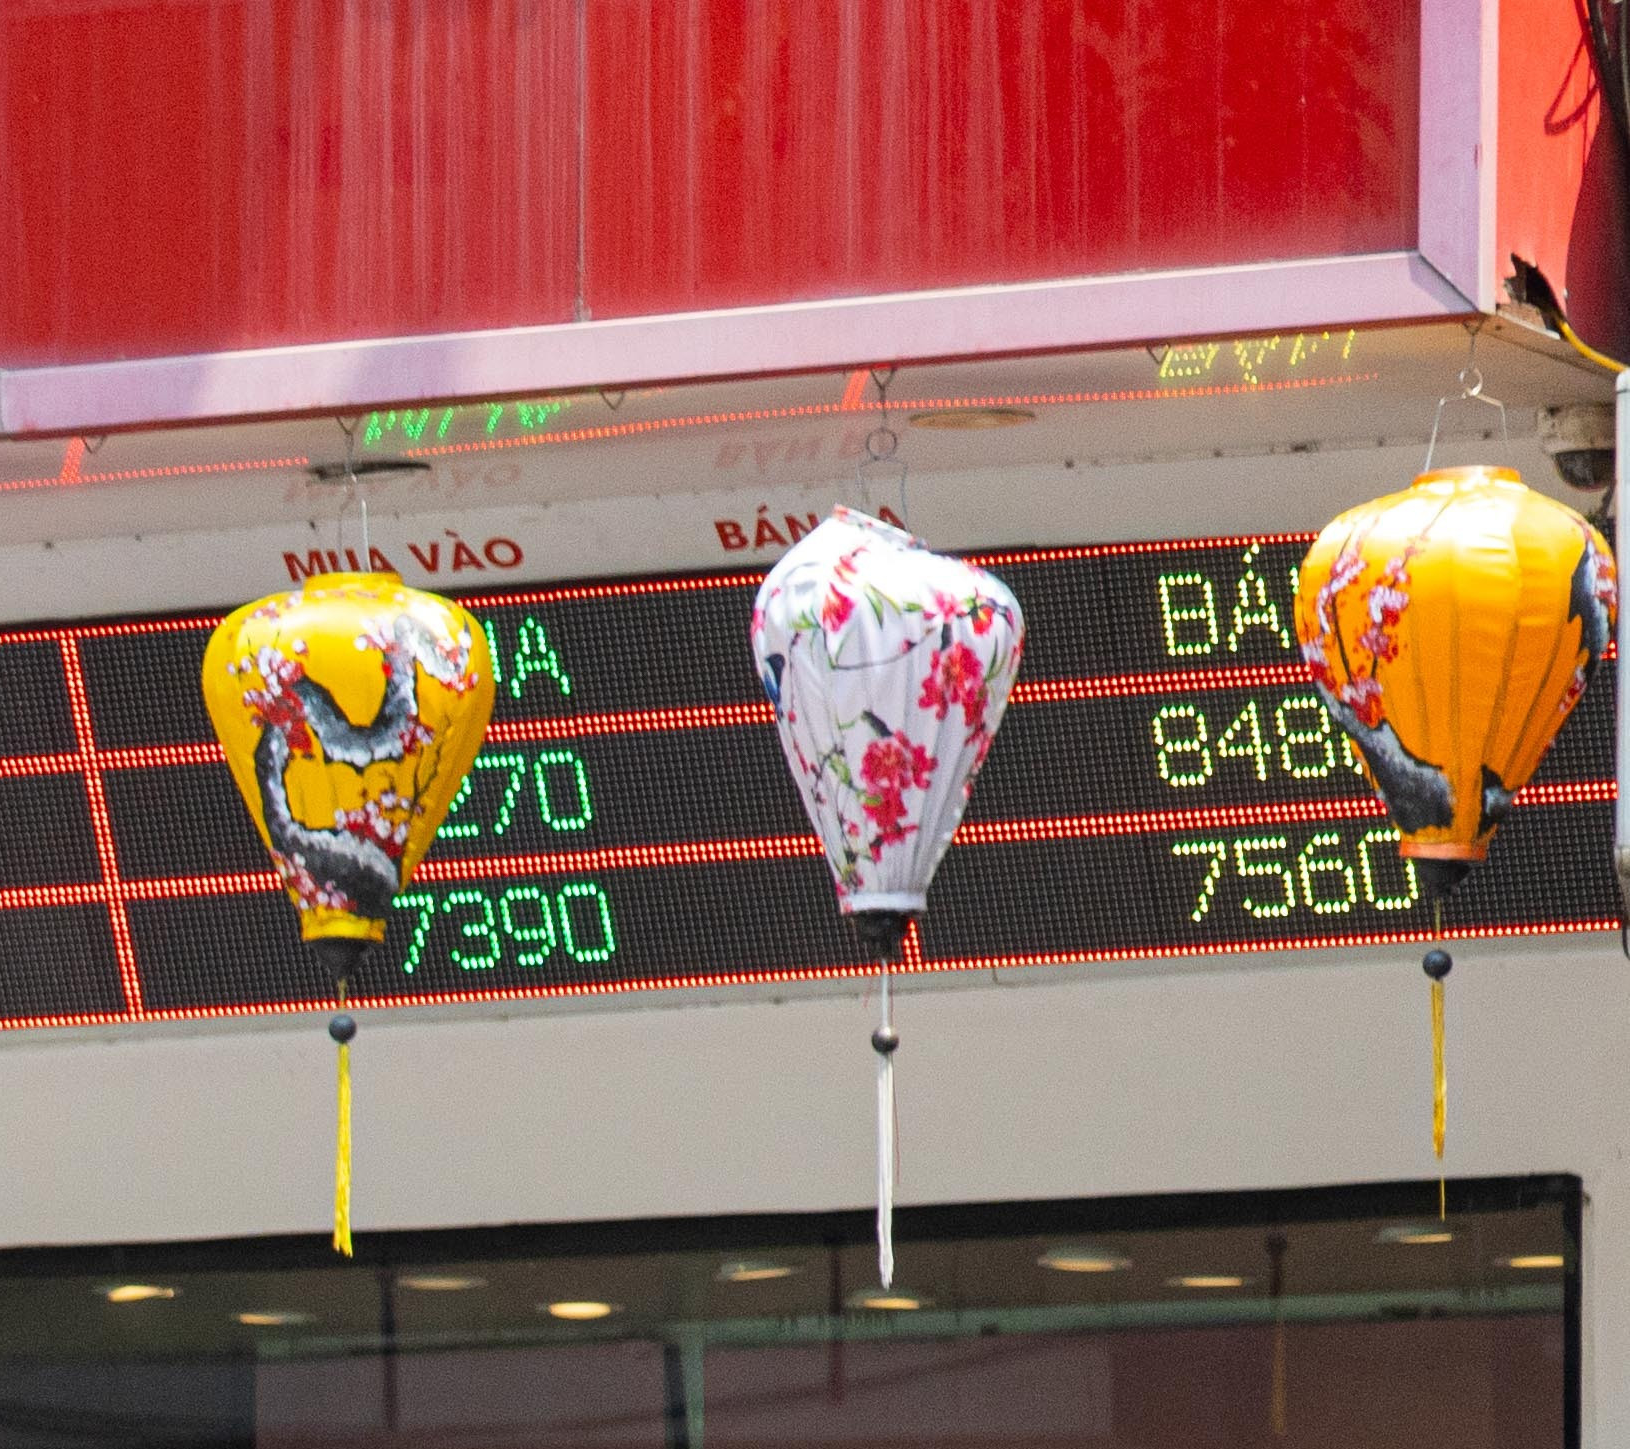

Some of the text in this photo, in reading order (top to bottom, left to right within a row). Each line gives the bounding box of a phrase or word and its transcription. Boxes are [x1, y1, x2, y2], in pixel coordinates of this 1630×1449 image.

[407, 528, 524, 575] VÀO
[1157, 542, 1302, 657] BÁ
[1152, 696, 1364, 788] 848
[1171, 828, 1420, 923] 7560
[391, 882, 617, 975] 7390
